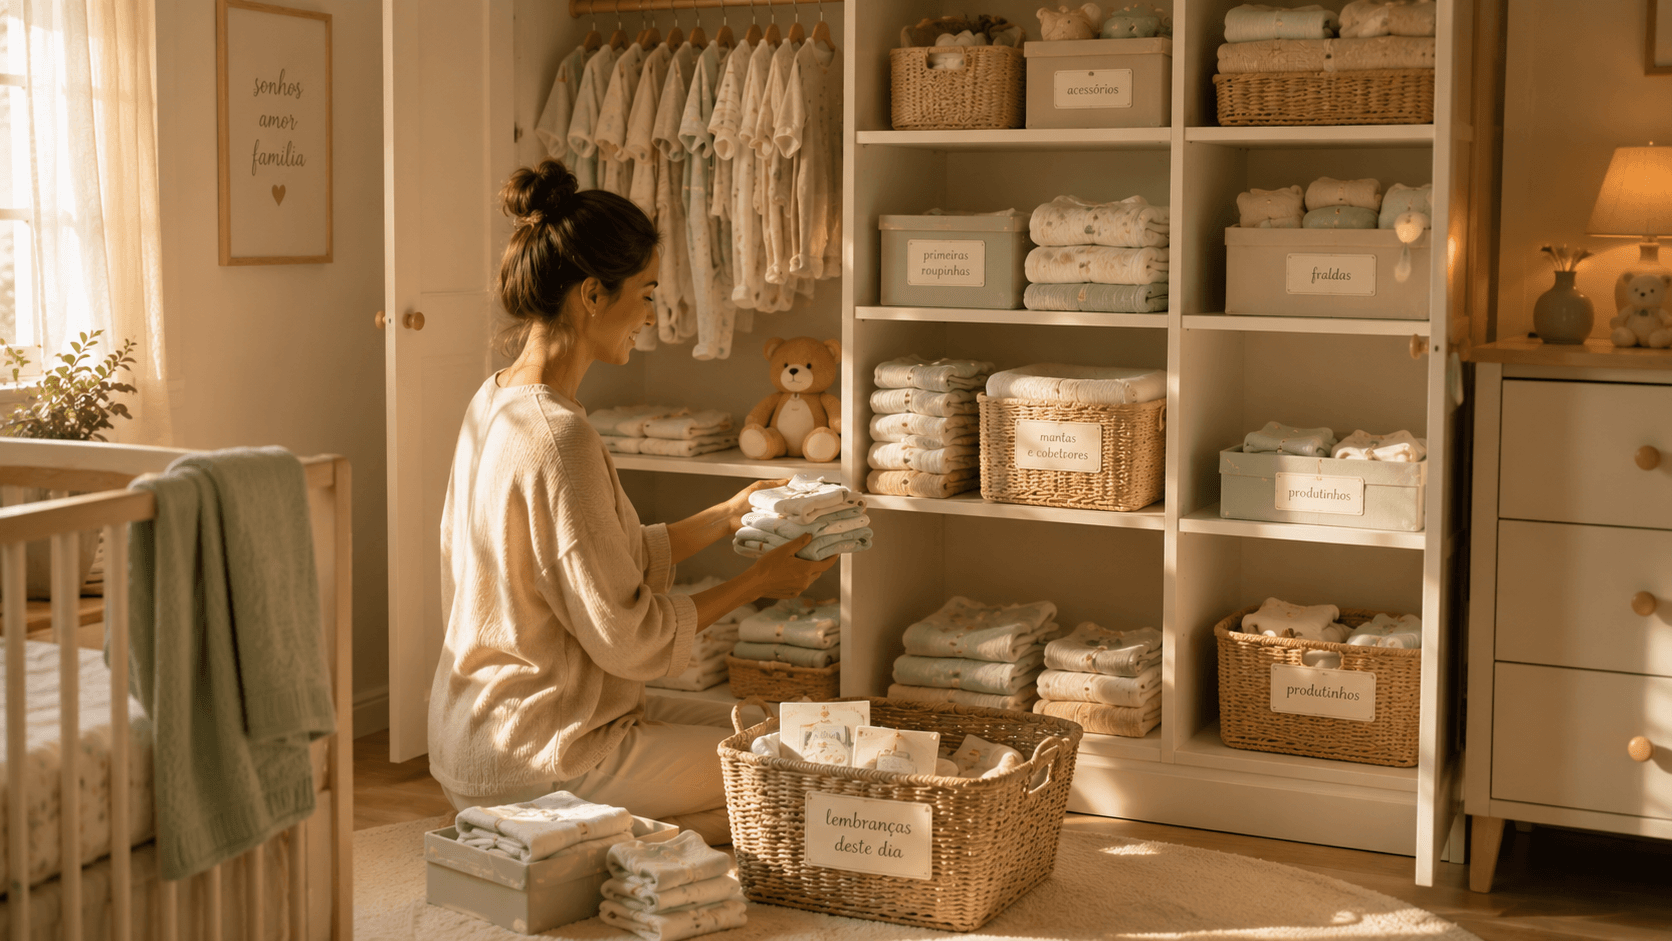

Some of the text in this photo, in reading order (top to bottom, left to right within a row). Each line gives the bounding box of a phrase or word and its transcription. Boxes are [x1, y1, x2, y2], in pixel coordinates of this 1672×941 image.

[253, 68, 304, 99] sonhos
[1067, 83, 1119, 95] acessórios
[259, 114, 298, 130] amor
[923, 249, 969, 263] primeiras
[921, 265, 970, 279] roupinhas
[1311, 267, 1352, 284] fraldas
[1040, 433, 1077, 443] mantas
[1027, 449, 1034, 457] e
[1288, 486, 1352, 502] produtinhos
[1286, 683, 1360, 702] produtinhos
[826, 809, 912, 836] lembranças
[834, 836, 904, 858] deste dia
